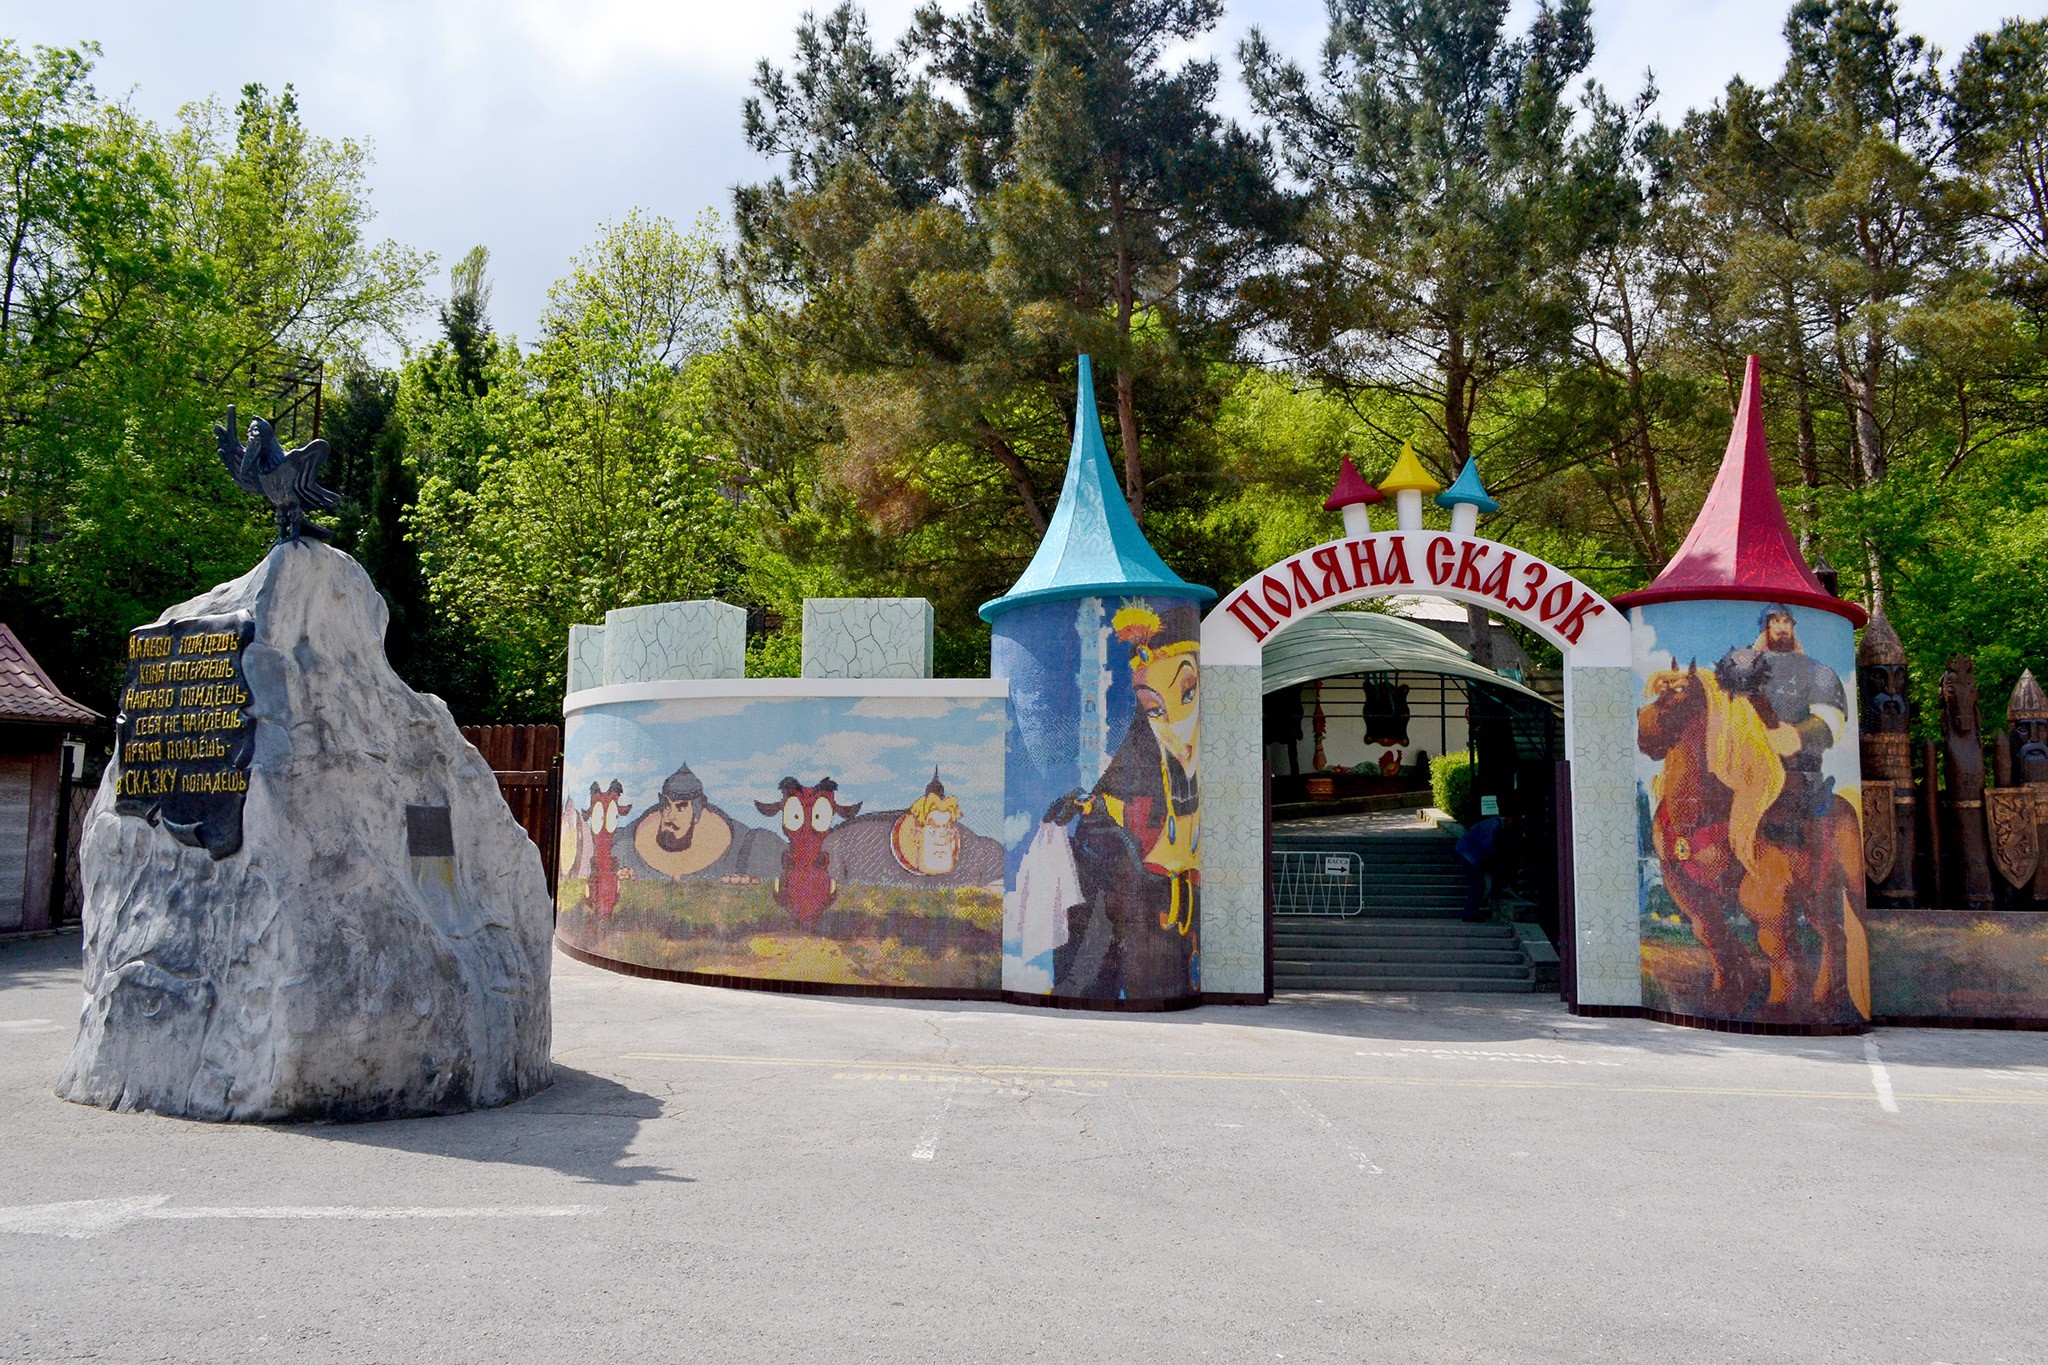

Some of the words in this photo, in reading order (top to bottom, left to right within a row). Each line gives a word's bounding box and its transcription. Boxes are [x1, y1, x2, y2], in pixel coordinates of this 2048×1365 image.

[1225, 536, 1415, 643] ПОЛЯНА
[1425, 536, 1606, 646] СКАЗОК
[129, 635, 172, 659] НАЛЕВО
[139, 663, 166, 684] КОНЯ
[125, 688, 175, 710] НАПРАВО
[135, 714, 162, 736] СЕБЯ
[164, 714, 180, 734] НЕ
[124, 741, 162, 763] ПРЯМО
[125, 767, 178, 796] СКАЗКУ
